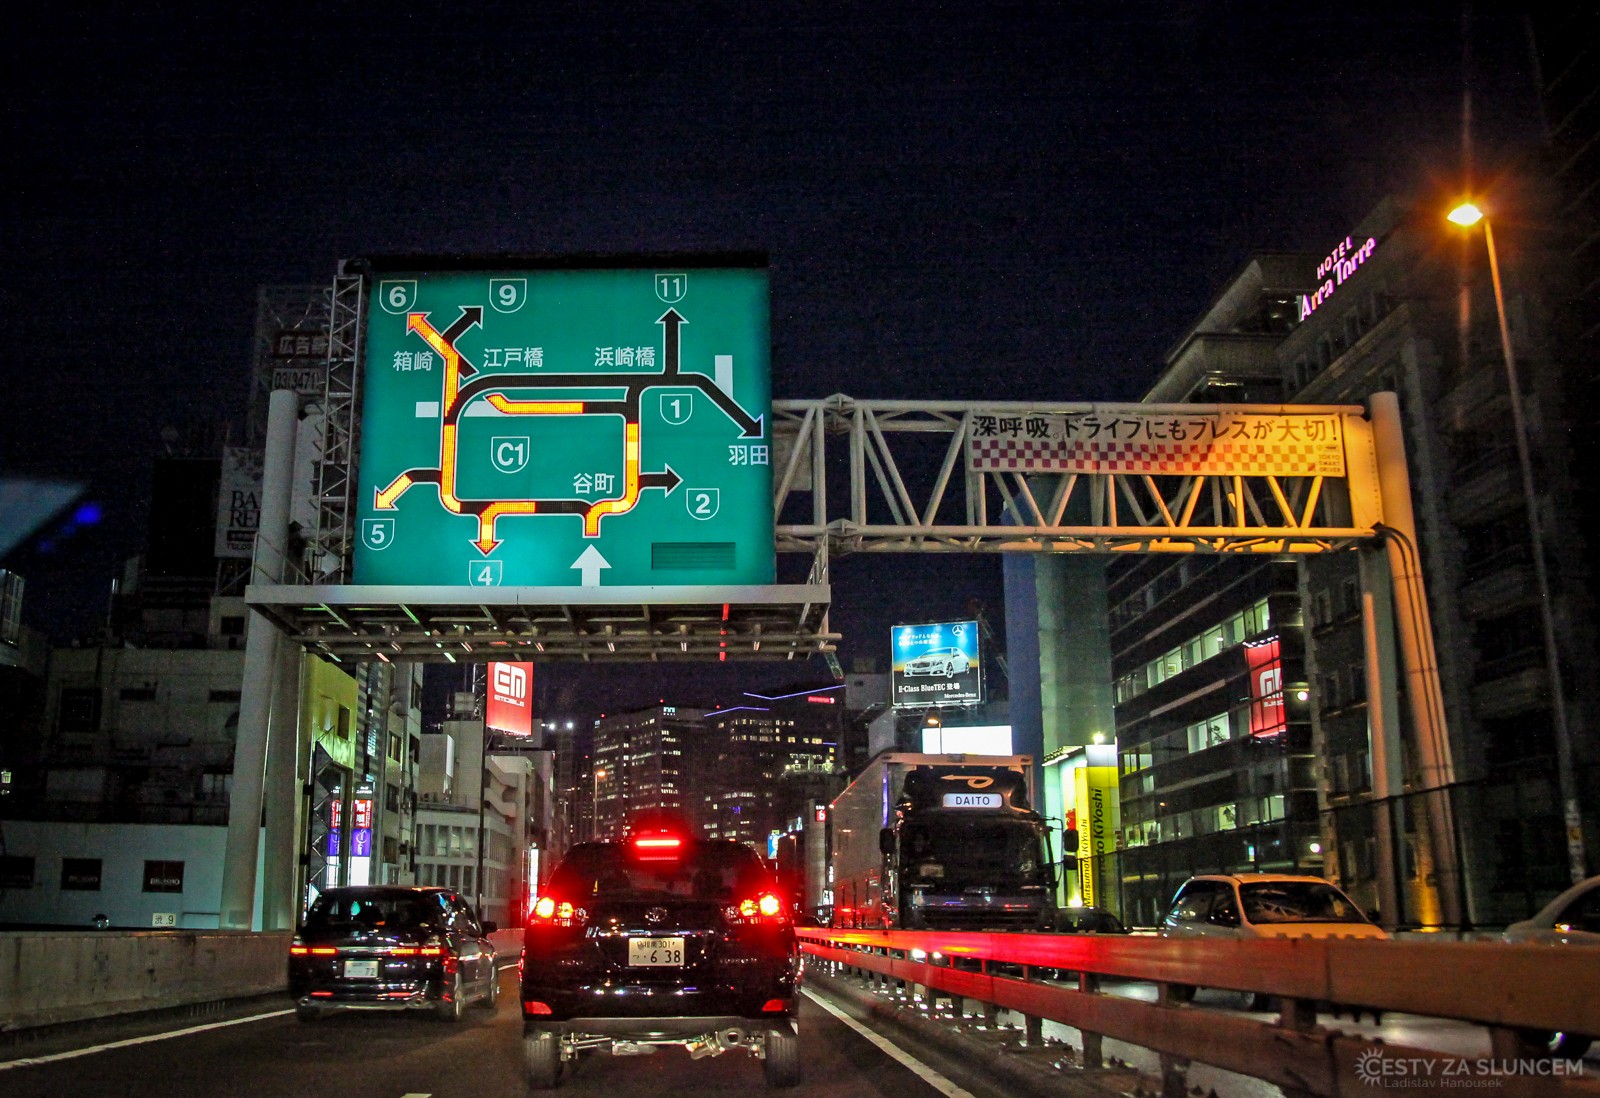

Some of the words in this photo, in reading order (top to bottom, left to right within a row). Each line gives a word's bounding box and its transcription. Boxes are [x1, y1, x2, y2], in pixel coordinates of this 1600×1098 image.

[1317, 236, 1353, 280] HOTEL
[1333, 237, 1377, 286] Torre
[389, 286, 407, 306] 6
[499, 284, 517, 305] 9
[660, 277, 681, 298] 11
[392, 350, 434, 372] 箱崎
[482, 347, 544, 369] 江戸橋
[594, 346, 656, 367] 浜崎橋
[670, 399, 681, 419] 1
[497, 442, 525, 467] C1
[728, 445, 770, 467] 羽田
[572, 472, 615, 495] 谷町
[231, 490, 262, 509] BA
[695, 494, 710, 514] 2
[370, 524, 385, 545] 5
[477, 565, 493, 586] 4
[898, 685, 920, 693] E-Class
[920, 683, 946, 692] BlueTEC
[955, 796, 990, 806] DAITO
